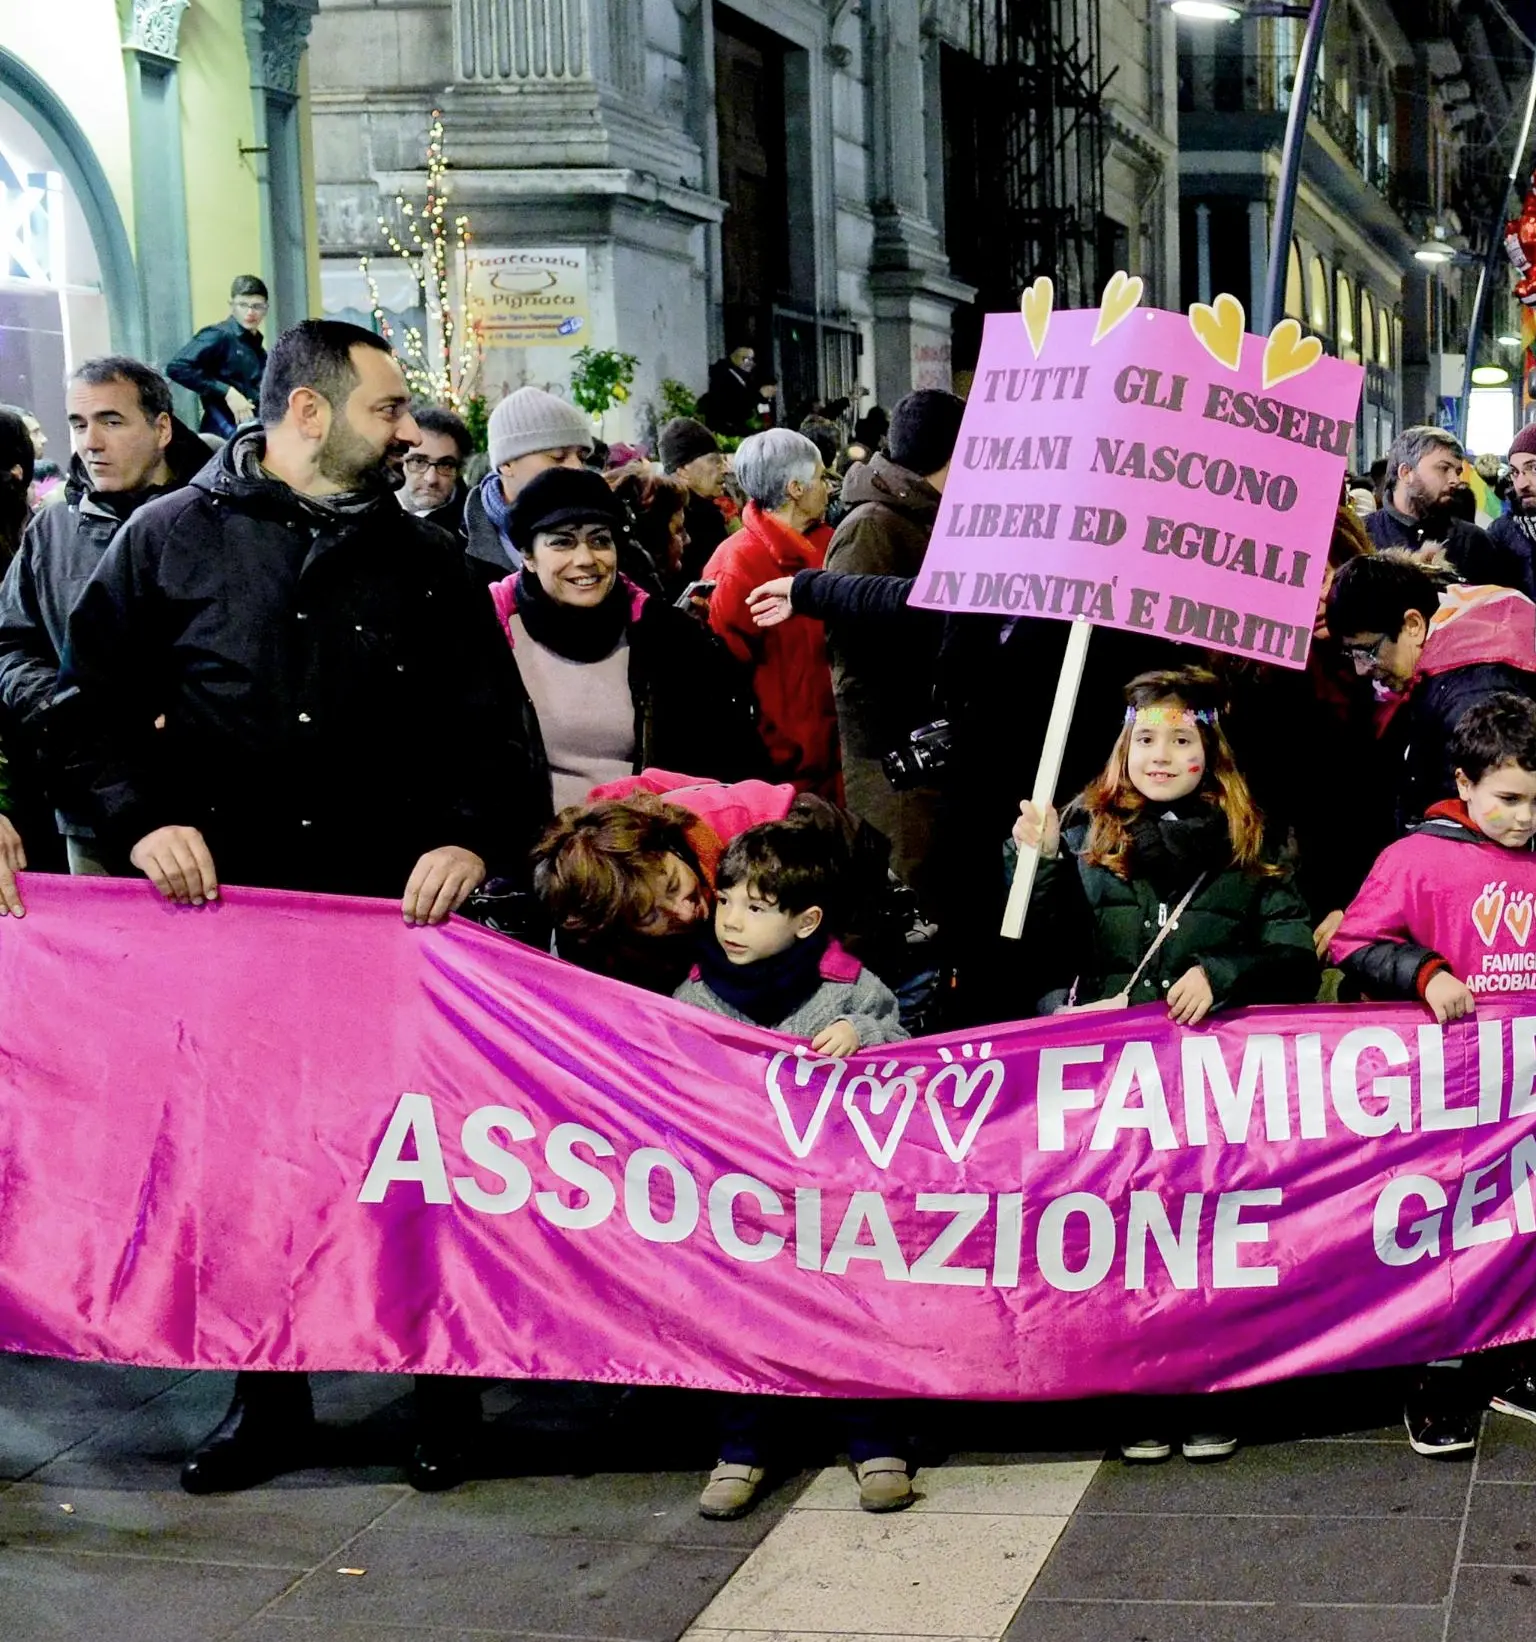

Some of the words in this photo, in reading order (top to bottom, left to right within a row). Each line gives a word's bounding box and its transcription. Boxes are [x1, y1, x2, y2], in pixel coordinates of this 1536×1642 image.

[493, 294, 575, 308] Pignata
[984, 365, 1090, 403] TUTTI
[1113, 365, 1190, 412] GLI
[1202, 383, 1355, 457] ESSERI
[962, 435, 1073, 471] UMANI
[1090, 437, 1298, 512] NASCONO
[946, 503, 1061, 540] LIBERI
[1069, 506, 1127, 546] ED
[1142, 514, 1311, 588] EGUALI
[922, 571, 967, 605] IN
[1125, 588, 1160, 630] E
[1164, 595, 1311, 663] DIRITTI
[357, 1092, 1282, 1292] ASSOCIAZIONE
